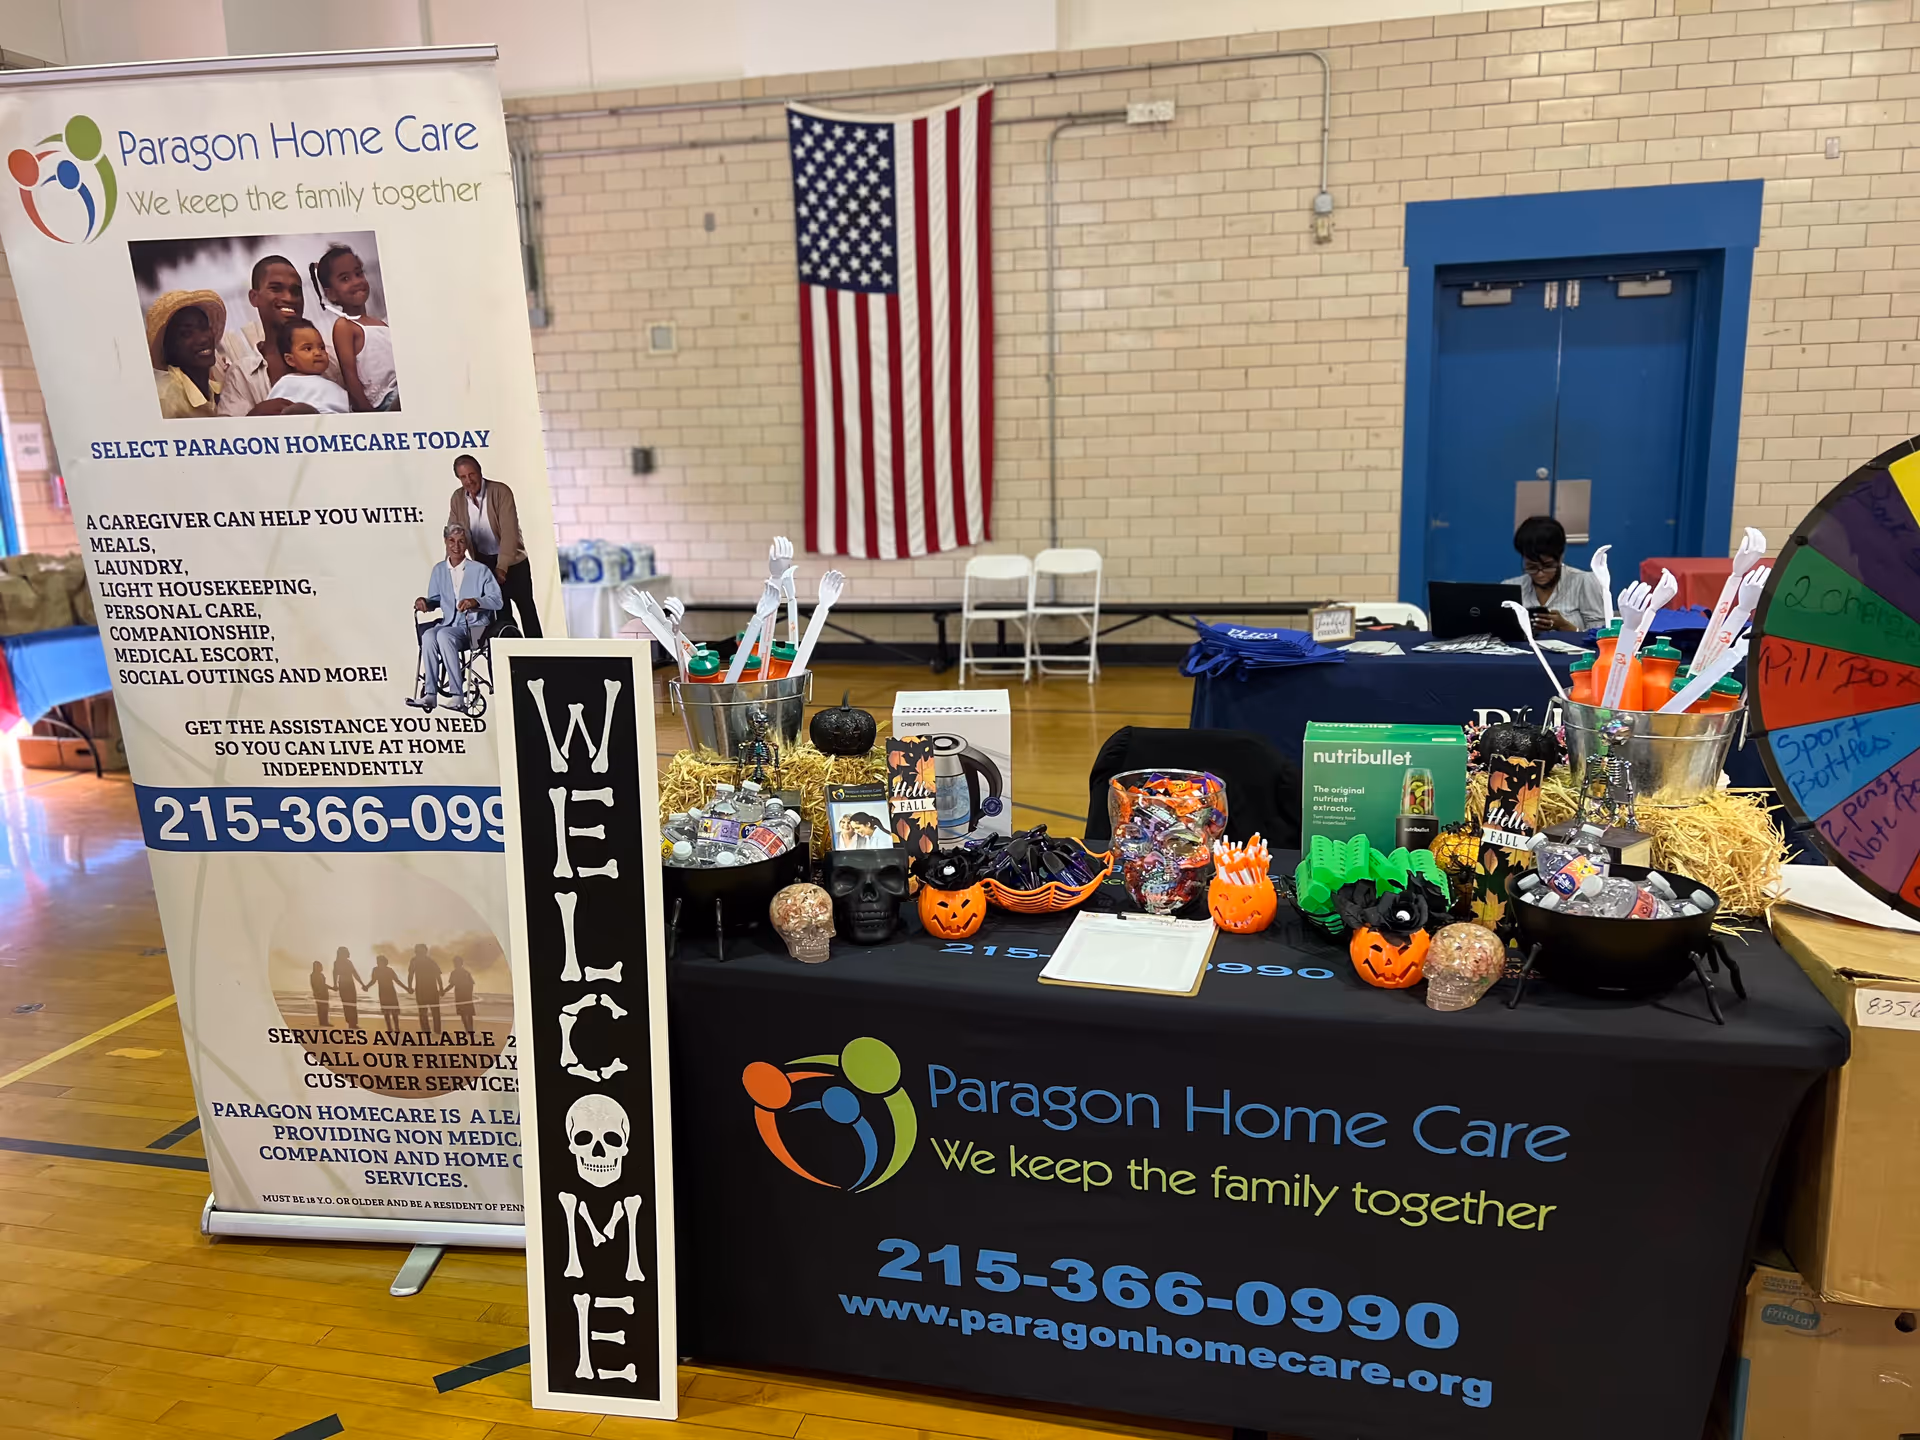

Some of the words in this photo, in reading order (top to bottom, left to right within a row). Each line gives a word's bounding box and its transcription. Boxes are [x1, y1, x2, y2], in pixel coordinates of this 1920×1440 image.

[118, 130, 259, 171] Paragon
[269, 121, 383, 159] Home
[394, 114, 479, 152] Care
[127, 190, 170, 216] We
[176, 189, 238, 218] keep
[246, 185, 288, 212] the
[295, 181, 364, 212] family
[372, 176, 482, 210] together
[91, 440, 168, 459] SELECT
[173, 436, 280, 457] PARAGON
[284, 432, 410, 454] HOMECARE
[413, 430, 490, 449] TODAY
[86, 514, 98, 530] A
[99, 512, 211, 530] CAREGIVER
[214, 511, 256, 527] CAN
[259, 510, 311, 527] HELP
[315, 508, 358, 525] YOU
[362, 506, 424, 523] WITH:
[89, 537, 156, 554] MEALS,
[94, 559, 189, 576] LAUNDRY,
[99, 582, 153, 597] LIGHT
[158, 579, 318, 597] HOUSEKEEPING,
[104, 603, 202, 619] PERSONAL
[205, 602, 262, 619] CARE,
[109, 624, 276, 641] COMPANIONSHIP,
[114, 648, 198, 663] MEDICAL
[201, 647, 280, 663] ESCORT,
[119, 670, 184, 685] SOCIAL
[187, 669, 275, 684] OUTINGS
[278, 668, 321, 683] AND
[325, 666, 389, 682] MORE!
[1759, 646, 1829, 687] Pill
[184, 720, 223, 736] GET
[226, 719, 266, 735] THE
[268, 718, 388, 735] ASSISTANCE
[389, 718, 431, 732] YOU
[435, 717, 488, 733] NEED
[214, 741, 239, 756] SO
[240, 741, 281, 756] YOU
[284, 740, 327, 756] CAN
[329, 740, 376, 755] LIVE
[378, 739, 404, 754] AT
[407, 738, 467, 755] HOME
[262, 760, 424, 777] INDEPENDENTLY
[892, 781, 932, 799] Hello
[1313, 785, 1330, 794] The
[1331, 786, 1365, 797] original
[1313, 795, 1348, 803] nutrient
[900, 800, 927, 812] FALL
[1313, 804, 1356, 813] extractor.
[1487, 806, 1530, 832] Hello
[1490, 831, 1518, 848] FALL
[268, 1028, 368, 1045] SERVICES
[373, 1031, 496, 1047] AVAILABLE
[304, 1051, 360, 1067] CALL
[363, 1052, 410, 1068] OUR
[412, 1053, 518, 1070] FRIENDLY
[304, 1073, 424, 1091] CUSTOMER
[212, 1102, 313, 1120] PARAGON
[316, 1105, 437, 1124] HOMECARE
[441, 1108, 461, 1124] IS
[470, 1109, 486, 1124] A
[928, 1064, 1160, 1131] Paragon
[1186, 1086, 1388, 1148] Home
[1412, 1105, 1571, 1162] Care
[273, 1125, 392, 1143] PROVIDING
[395, 1129, 443, 1145] NON
[447, 1130, 522, 1147] MEDIC
[259, 1146, 389, 1164] COMPANION
[393, 1150, 440, 1166] AND
[444, 1152, 509, 1168] HOME
[364, 1170, 469, 1188] SERVICES.
[930, 1137, 996, 1174] We
[1009, 1145, 1112, 1192] keep
[1127, 1158, 1196, 1196] the
[1211, 1165, 1340, 1217] family
[1351, 1181, 1557, 1232] together
[262, 1194, 291, 1203] MUST
[292, 1195, 305, 1204] BE
[336, 1197, 351, 1205] OR
[351, 1198, 385, 1207] OLDER
[386, 1199, 408, 1207] AND
[410, 1200, 422, 1208] BE
[424, 1201, 433, 1209] A
[433, 1201, 483, 1210] RESIDENT
[484, 1203, 498, 1211] OF
[877, 1238, 1459, 1349] 215-366-0990
[838, 1293, 1493, 1408] www.paragonhomecare.org
